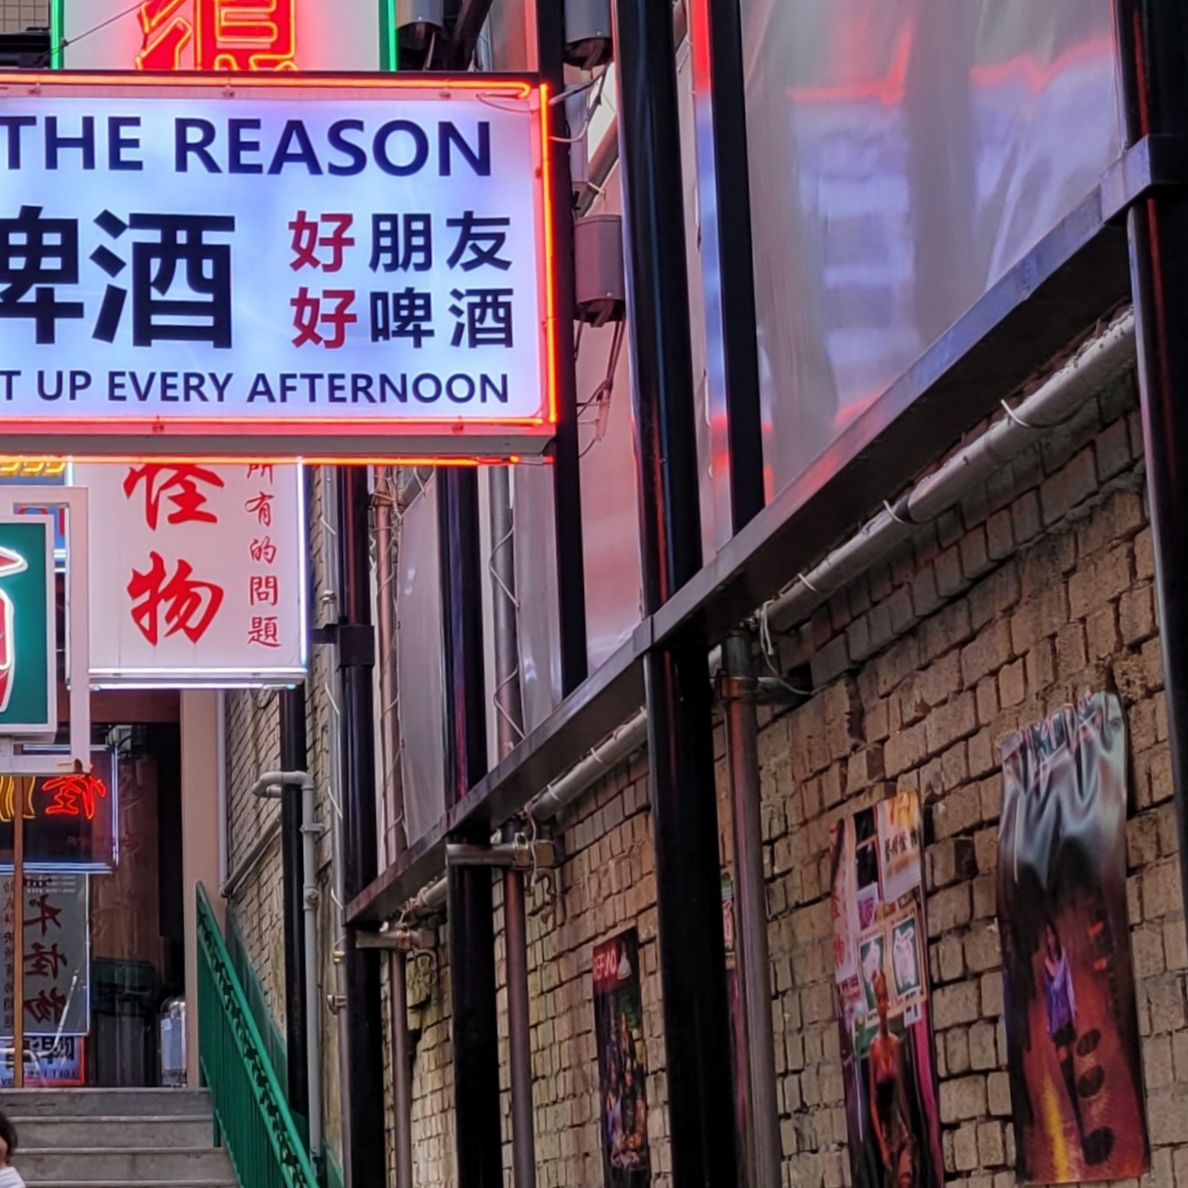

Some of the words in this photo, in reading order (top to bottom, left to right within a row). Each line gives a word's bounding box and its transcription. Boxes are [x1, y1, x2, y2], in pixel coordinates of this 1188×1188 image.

[174, 116, 492, 178] REASON
[287, 209, 513, 274] 好朋友
[289, 286, 514, 350] 好啤酒
[36, 369, 93, 402] UP
[107, 370, 234, 403] EVERY
[245, 372, 509, 404] AFTERNOON
[123, 463, 225, 646] 怪物
